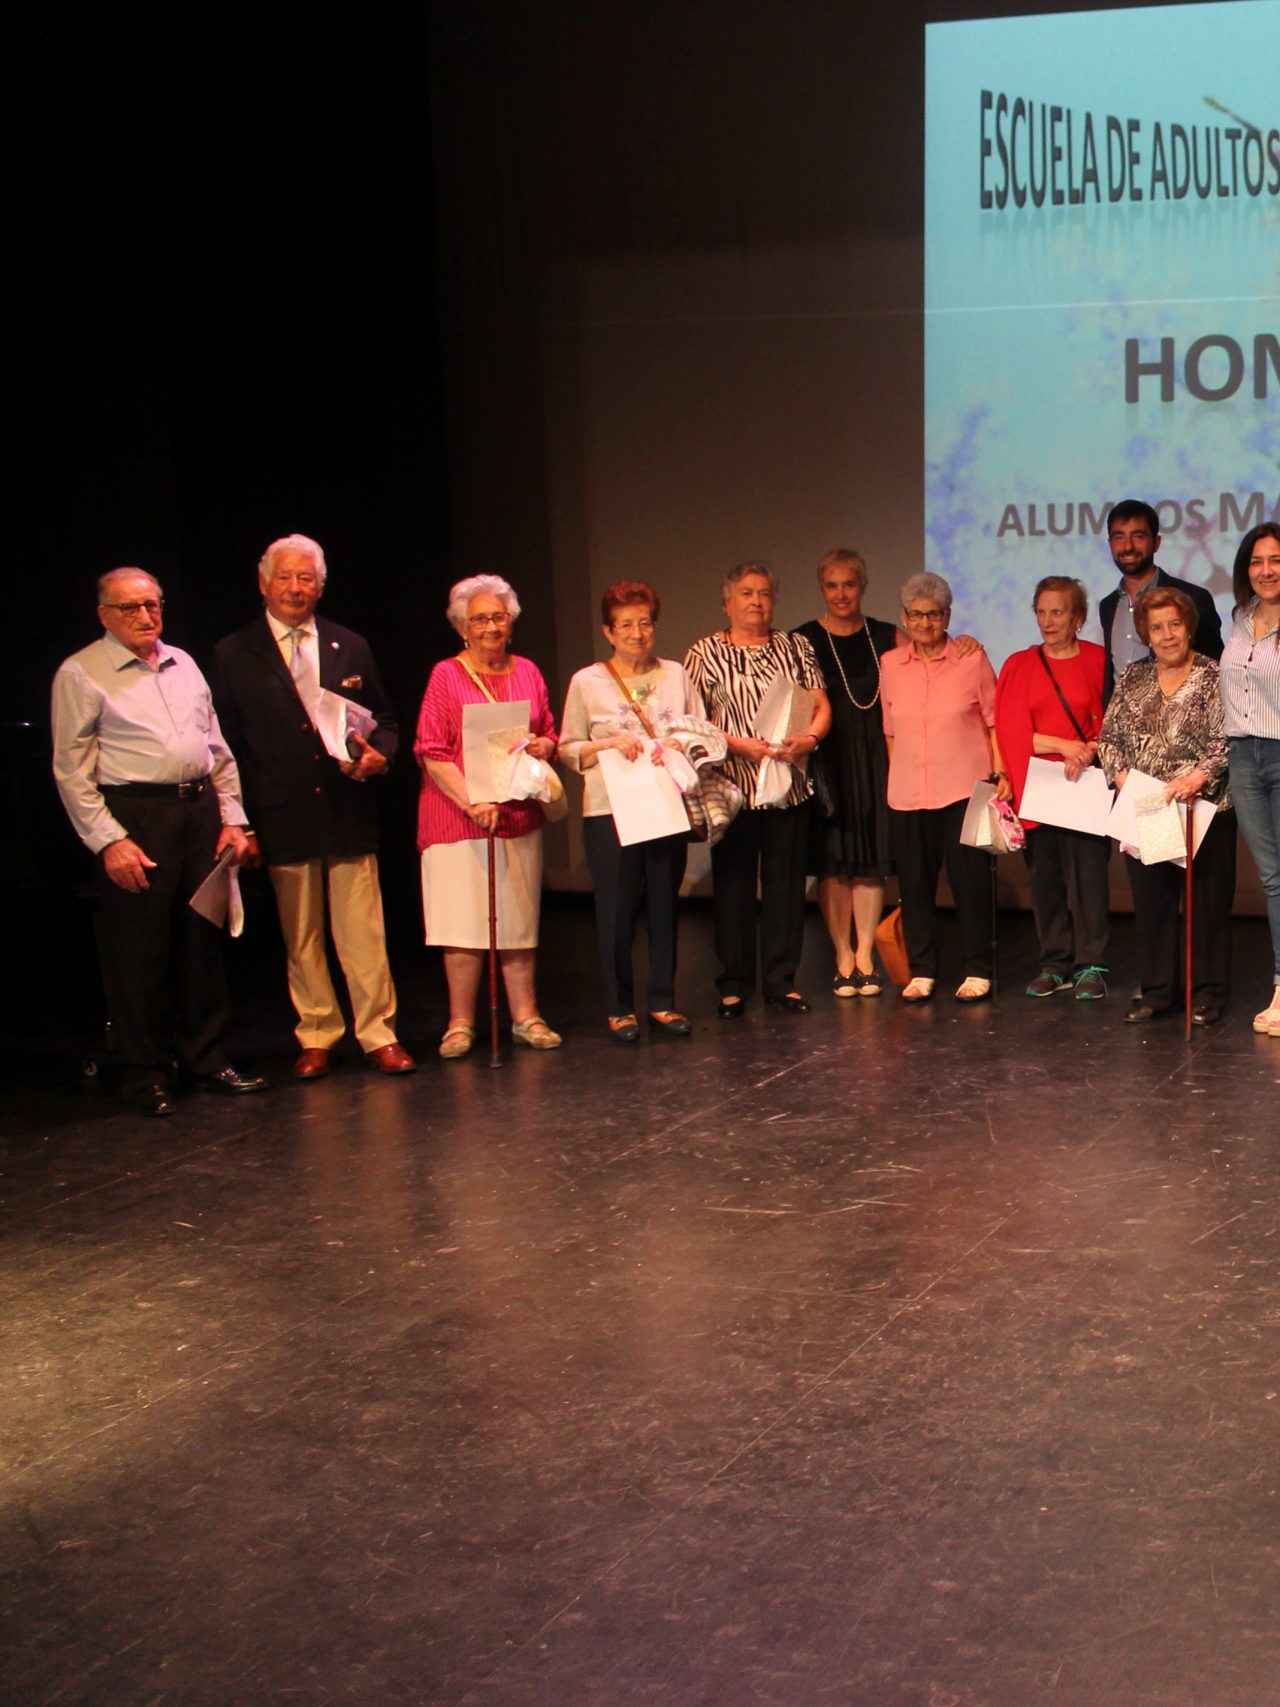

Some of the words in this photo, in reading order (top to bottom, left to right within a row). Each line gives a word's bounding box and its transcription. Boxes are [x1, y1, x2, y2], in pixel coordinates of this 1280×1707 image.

[980, 89, 1101, 209] ESCUELA
[1106, 115, 1143, 202] DE
[997, 499, 1206, 537] ALUMOS
